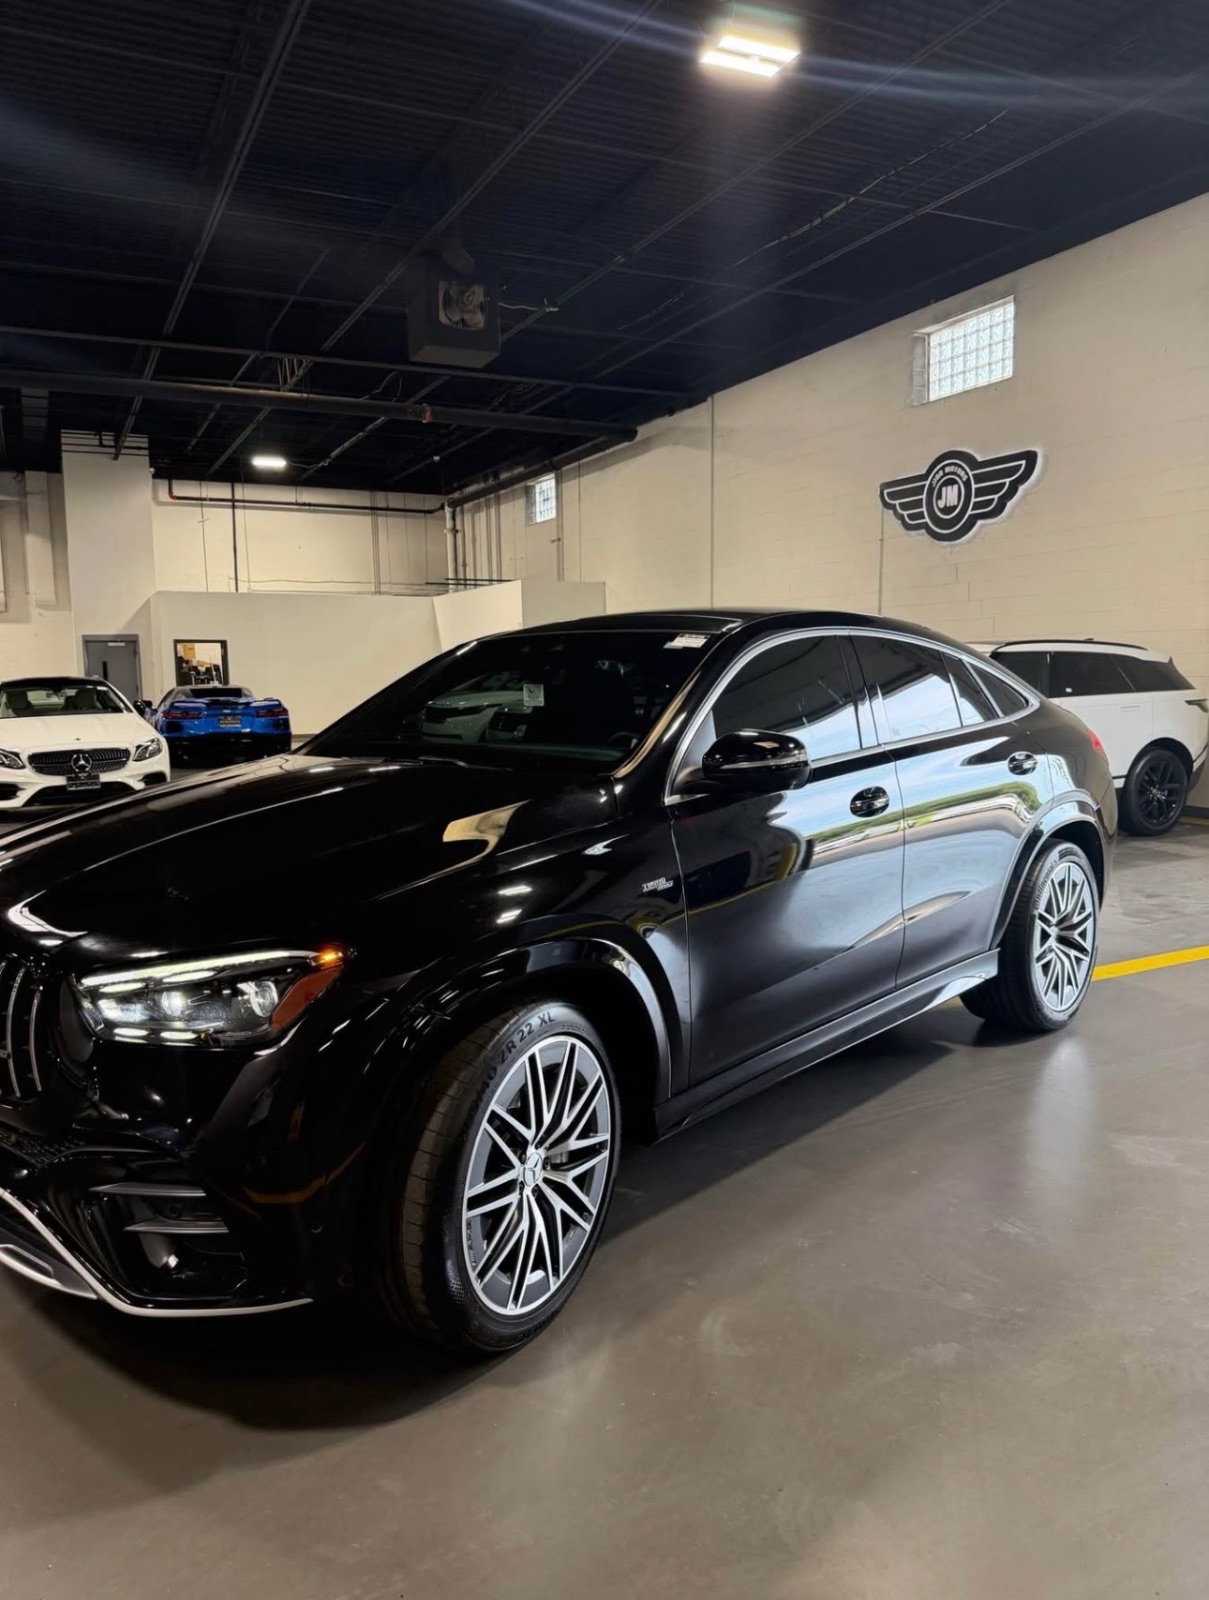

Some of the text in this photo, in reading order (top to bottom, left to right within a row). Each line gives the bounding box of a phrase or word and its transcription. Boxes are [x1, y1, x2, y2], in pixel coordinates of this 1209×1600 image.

[944, 465, 968, 482] MOTORS
[937, 484, 959, 509] JM
[499, 1040, 518, 1065] ZR
[517, 1022, 535, 1043] 22
[537, 1011, 555, 1028] XL
